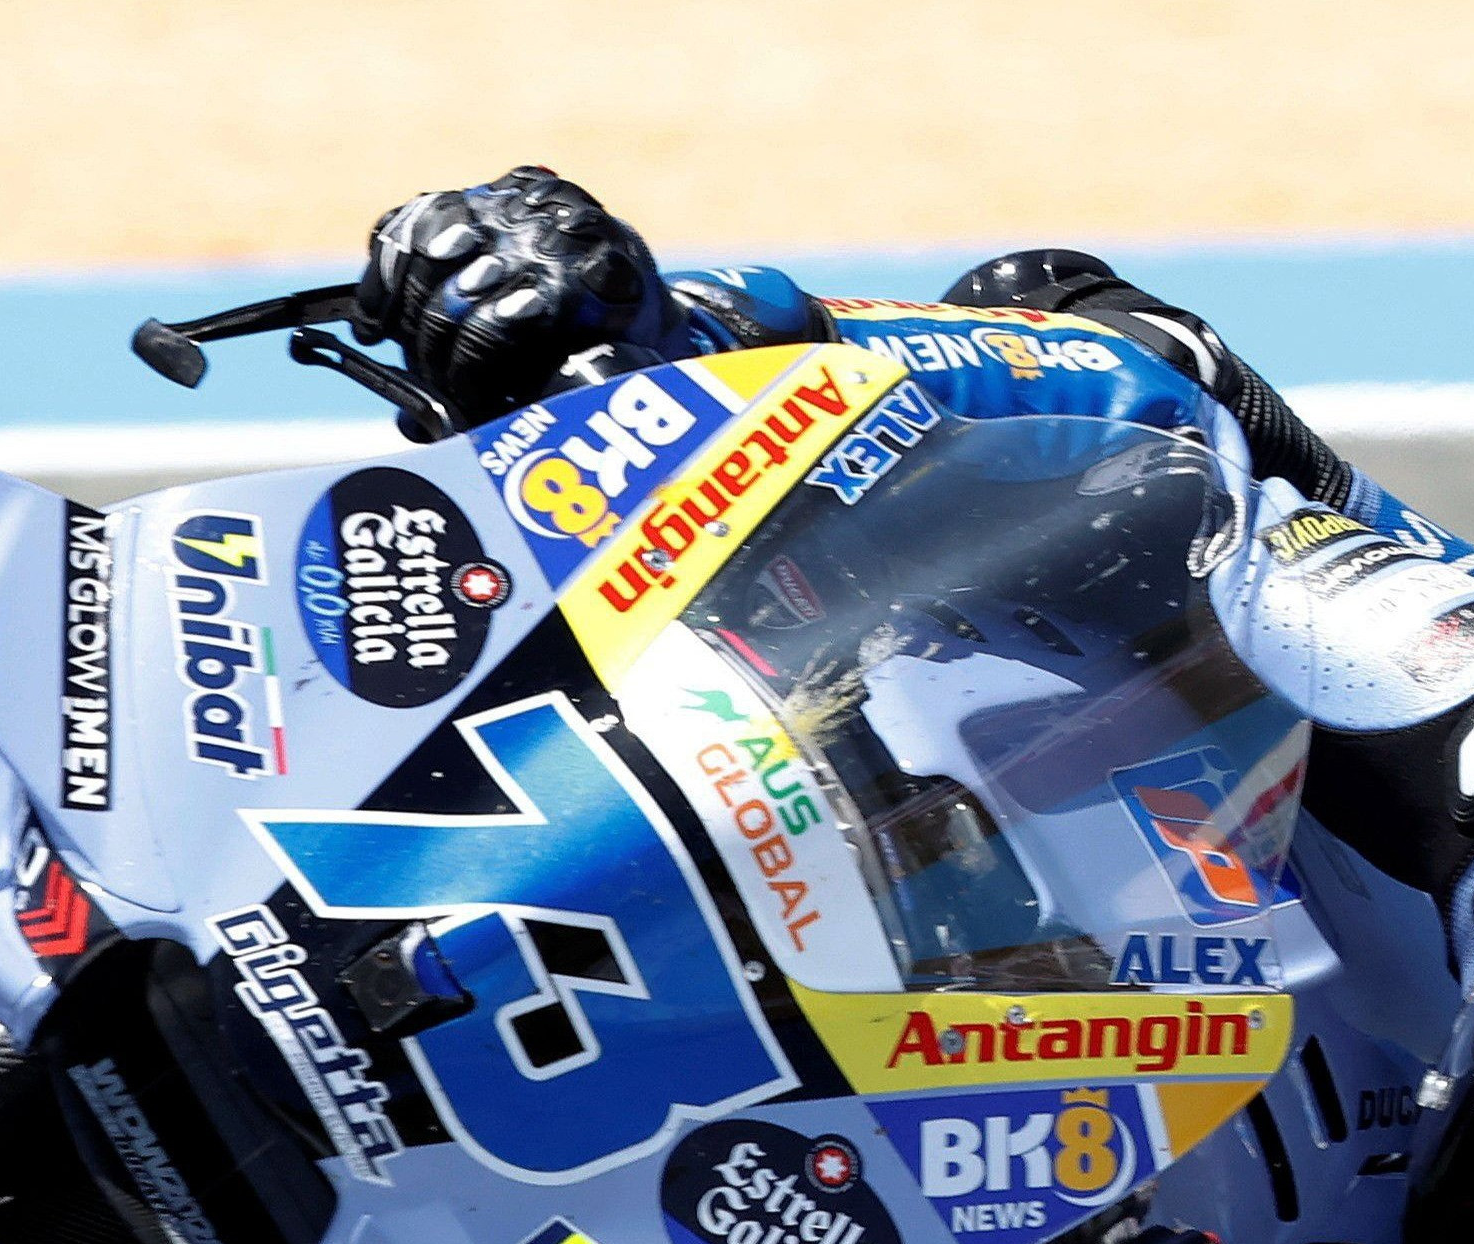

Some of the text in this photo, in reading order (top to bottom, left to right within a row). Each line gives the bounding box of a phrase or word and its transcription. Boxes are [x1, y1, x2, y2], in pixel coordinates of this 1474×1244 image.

[842, 334, 982, 373] NEW
[479, 403, 559, 477] NEWS
[516, 373, 698, 541] BK8
[597, 365, 855, 614] Antangin
[806, 380, 942, 505] ALEX
[67, 577, 110, 694] GLOW
[171, 508, 276, 781] Unibat
[339, 511, 407, 666] Galicia
[391, 504, 459, 670] Estrella
[63, 711, 109, 806] MEN
[735, 736, 823, 836] AUS
[696, 742, 822, 954] GLOBAL
[238, 690, 804, 1186] 73
[1112, 932, 1275, 985] ALEX
[885, 1001, 1251, 1073] Antangin
[920, 1098, 1128, 1198] BK8
[952, 1200, 1047, 1237] NEWS
